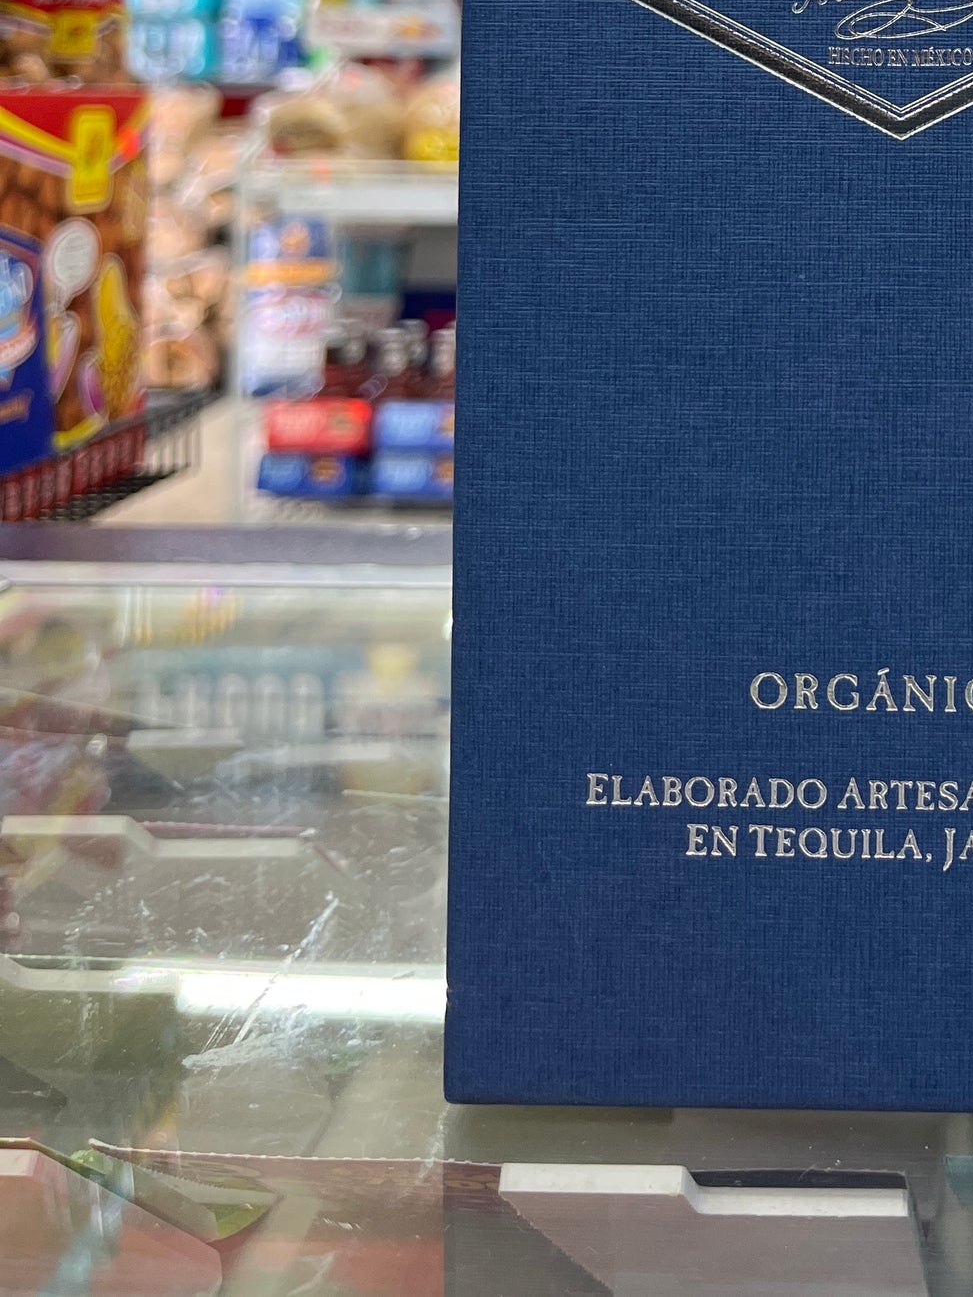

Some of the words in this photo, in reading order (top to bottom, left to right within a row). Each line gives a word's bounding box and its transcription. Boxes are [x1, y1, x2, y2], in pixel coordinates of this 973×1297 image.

[828, 46, 885, 67] HECHO
[887, 47, 908, 67] EN
[910, 45, 973, 67] MÉXICO
[586, 772, 828, 808] ELABORADO
[686, 823, 738, 857] EN
[749, 824, 934, 863] TEQUILA,
